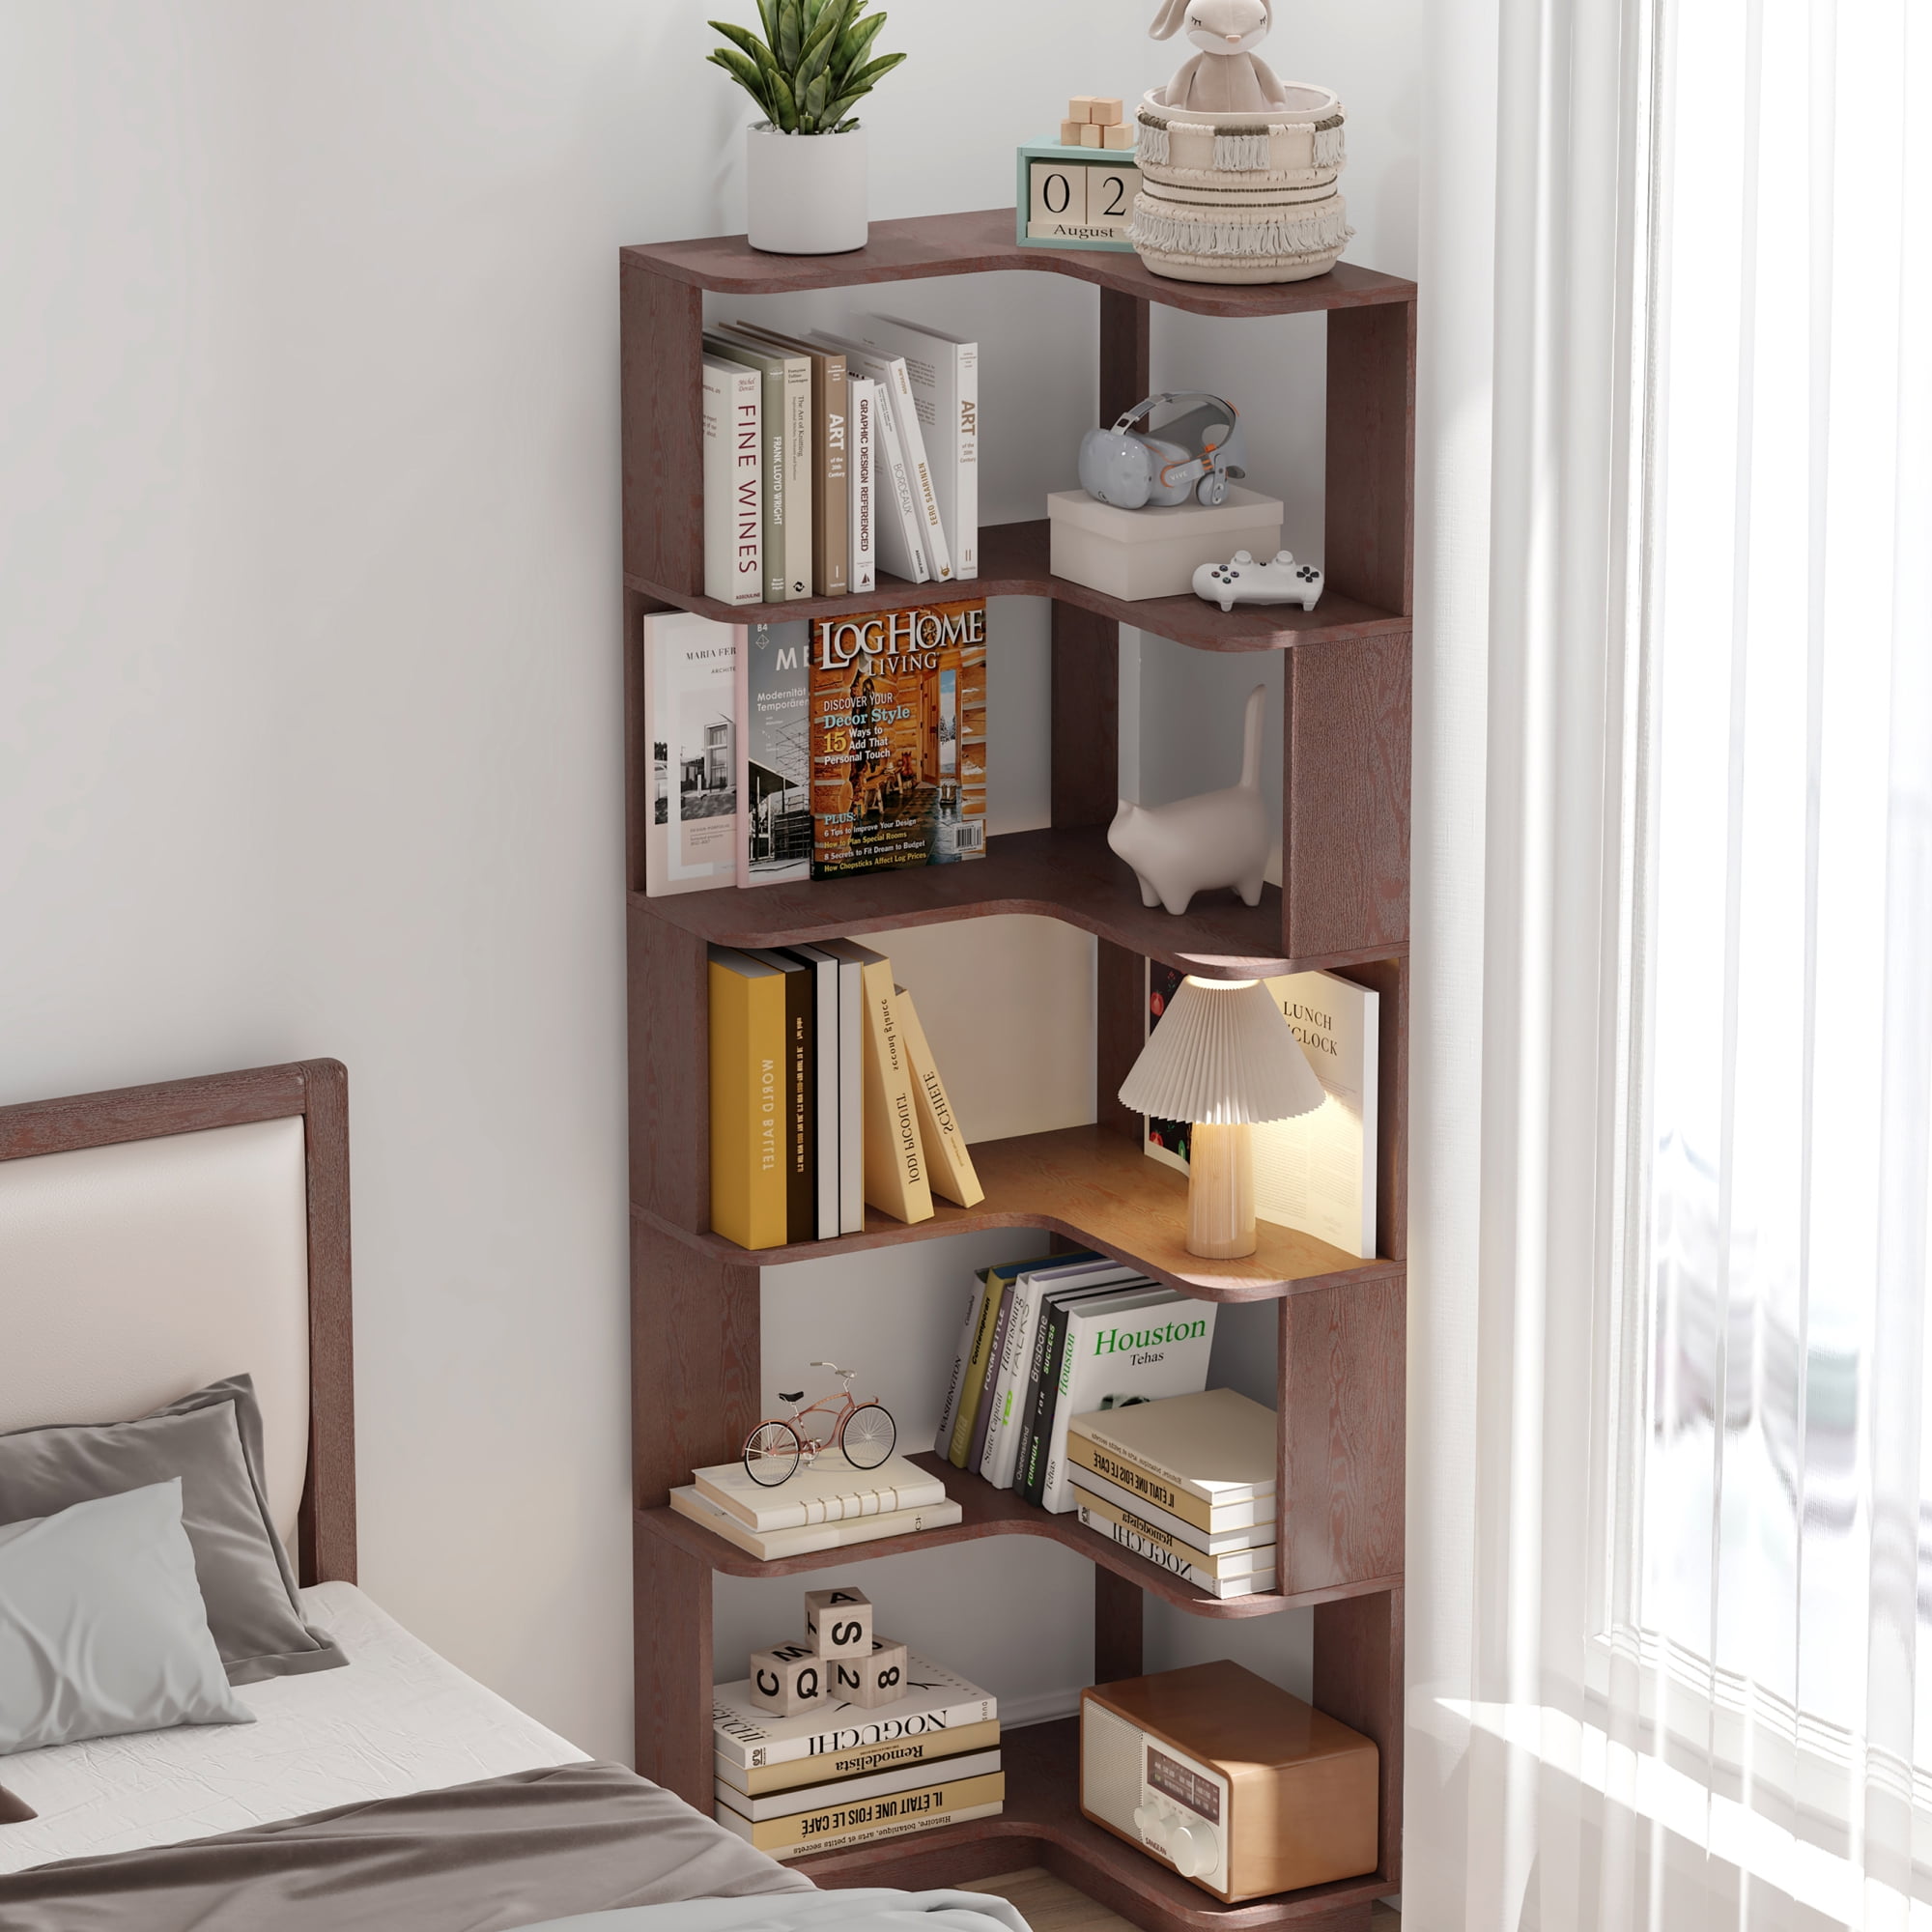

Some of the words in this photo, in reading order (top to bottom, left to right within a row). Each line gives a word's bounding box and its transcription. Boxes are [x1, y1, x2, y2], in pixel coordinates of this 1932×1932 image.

[1054, 224, 1115, 240] August
[860, 399, 868, 444] GRAPHIC
[961, 400, 976, 436] ART
[738, 405, 755, 468] FINE
[829, 413, 844, 450] ART
[773, 436, 782, 464] FRANK
[860, 446, 868, 484] DESIGN
[1170, 470, 1188, 480] VIVE
[773, 464, 782, 491] LLOYD
[918, 462, 933, 502] SAARINEN
[893, 463, 912, 517] BORDEAUX
[773, 492, 782, 526] WRIGHT
[860, 486, 869, 552] REFERENCED
[927, 504, 938, 526] EERO
[738, 480, 757, 573] WINES
[686, 649, 716, 661] MARIA
[869, 651, 937, 676] LIVING
[757, 688, 806, 701] Modernität
[823, 696, 867, 712] DISCOVER
[869, 692, 893, 705] YOUR
[823, 713, 867, 729] Decor
[871, 705, 910, 724] Style
[823, 730, 847, 753] 15
[848, 727, 871, 738] Ways
[849, 739, 867, 751] Add
[869, 737, 888, 747] That
[824, 752, 863, 765] Personal
[866, 748, 891, 760] Touch
[823, 811, 857, 826] PLUS:
[831, 828, 843, 837] Tips
[853, 822, 878, 833] Improve
[879, 820, 894, 829] Your
[862, 833, 885, 844] Special
[886, 831, 907, 840] Rooms
[831, 850, 855, 860] Secrets
[873, 844, 895, 854] Dream
[904, 840, 925, 849] Budget
[874, 856, 894, 866] Affect
[907, 852, 926, 861] Prices
[1283, 1001, 1331, 1031] LUNCH
[983, 1352, 995, 1391] FORM
[993, 1308, 1005, 1350] STYLE
[1093, 1320, 1206, 1356] Houston
[1002, 1390, 1012, 1426] TED
[1012, 1304, 1030, 1378] TALKS
[1130, 1352, 1165, 1366] Tehas
[984, 1435, 993, 1464] State
[989, 1392, 1003, 1433] Capital
[1001, 1293, 1024, 1372] Harrisburg
[940, 1355, 962, 1433] WASHINGTON
[1016, 1426, 1030, 1481] Queensland
[1030, 1315, 1048, 1383] Brisbane
[1028, 1435, 1039, 1487] FORMULA
[1043, 1323, 1056, 1375] SUCCESS
[1046, 1460, 1057, 1491] Tehas
[1059, 1333, 1075, 1397] Houston
[831, 1621, 862, 1646] S
[756, 1668, 780, 1697] C
[796, 1667, 819, 1699] Q
[877, 1665, 900, 1689] 8
[808, 1710, 947, 1756] NOGUCHI
[835, 1745, 923, 1772] Remodelista
[875, 1801, 896, 1820] UNE
[900, 1794, 929, 1812] ÉTAIT
[933, 1791, 943, 1806] IL
[802, 1816, 829, 1837] CAFÉ
[833, 1811, 845, 1829] LE
[848, 1806, 872, 1825] FOIS
[918, 1816, 951, 1828] Histoire,
[823, 1836, 846, 1848] petits
[858, 1832, 875, 1841] arts
[876, 1824, 916, 1837] botanique,
[793, 1843, 822, 1855] secrets
[1146, 1837, 1167, 1855] SANGEAN
